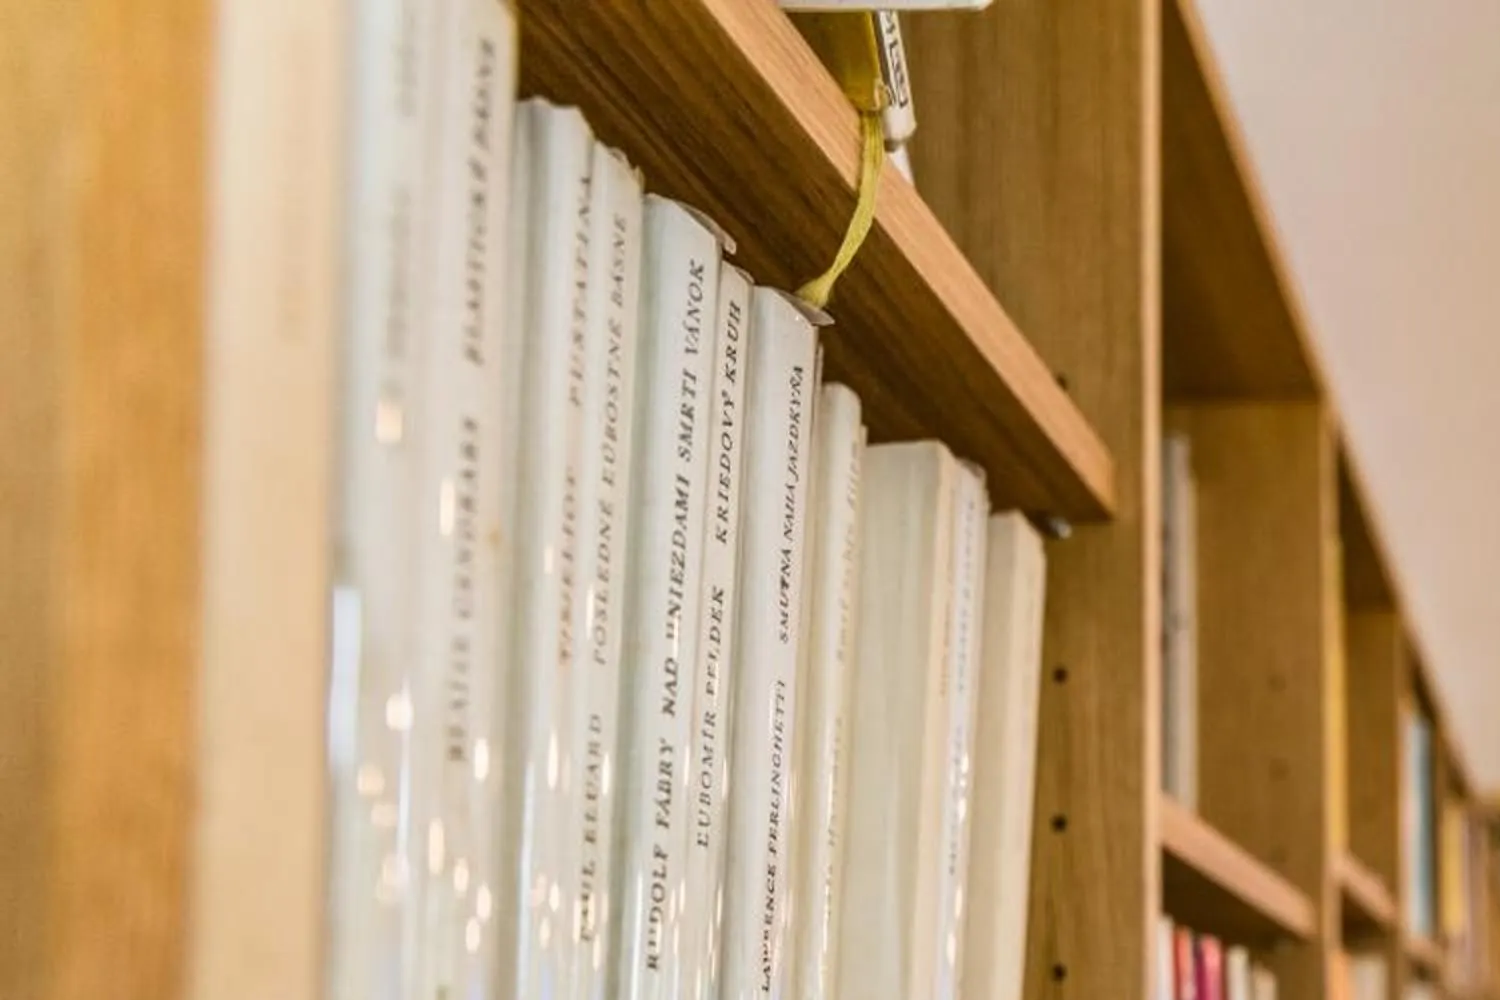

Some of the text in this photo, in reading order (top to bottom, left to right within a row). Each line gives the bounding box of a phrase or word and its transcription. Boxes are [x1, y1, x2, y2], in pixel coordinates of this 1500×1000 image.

[683, 260, 705, 355] VÁNOK
[724, 300, 742, 383] KRUH
[593, 499, 615, 664] POSLEDNÉ
[611, 213, 628, 306] BÁSNE
[676, 367, 697, 463] SMRTI
[714, 390, 737, 544] KRIEDOVÝ
[767, 680, 786, 856] FERLINGHETTI
[785, 366, 804, 481] JAZDKYŇA
[661, 657, 679, 717] NAD
[654, 738, 674, 829] FÁBRY
[696, 711, 716, 847] ĽUBOMÍR
[647, 845, 668, 970] RUDOLF
